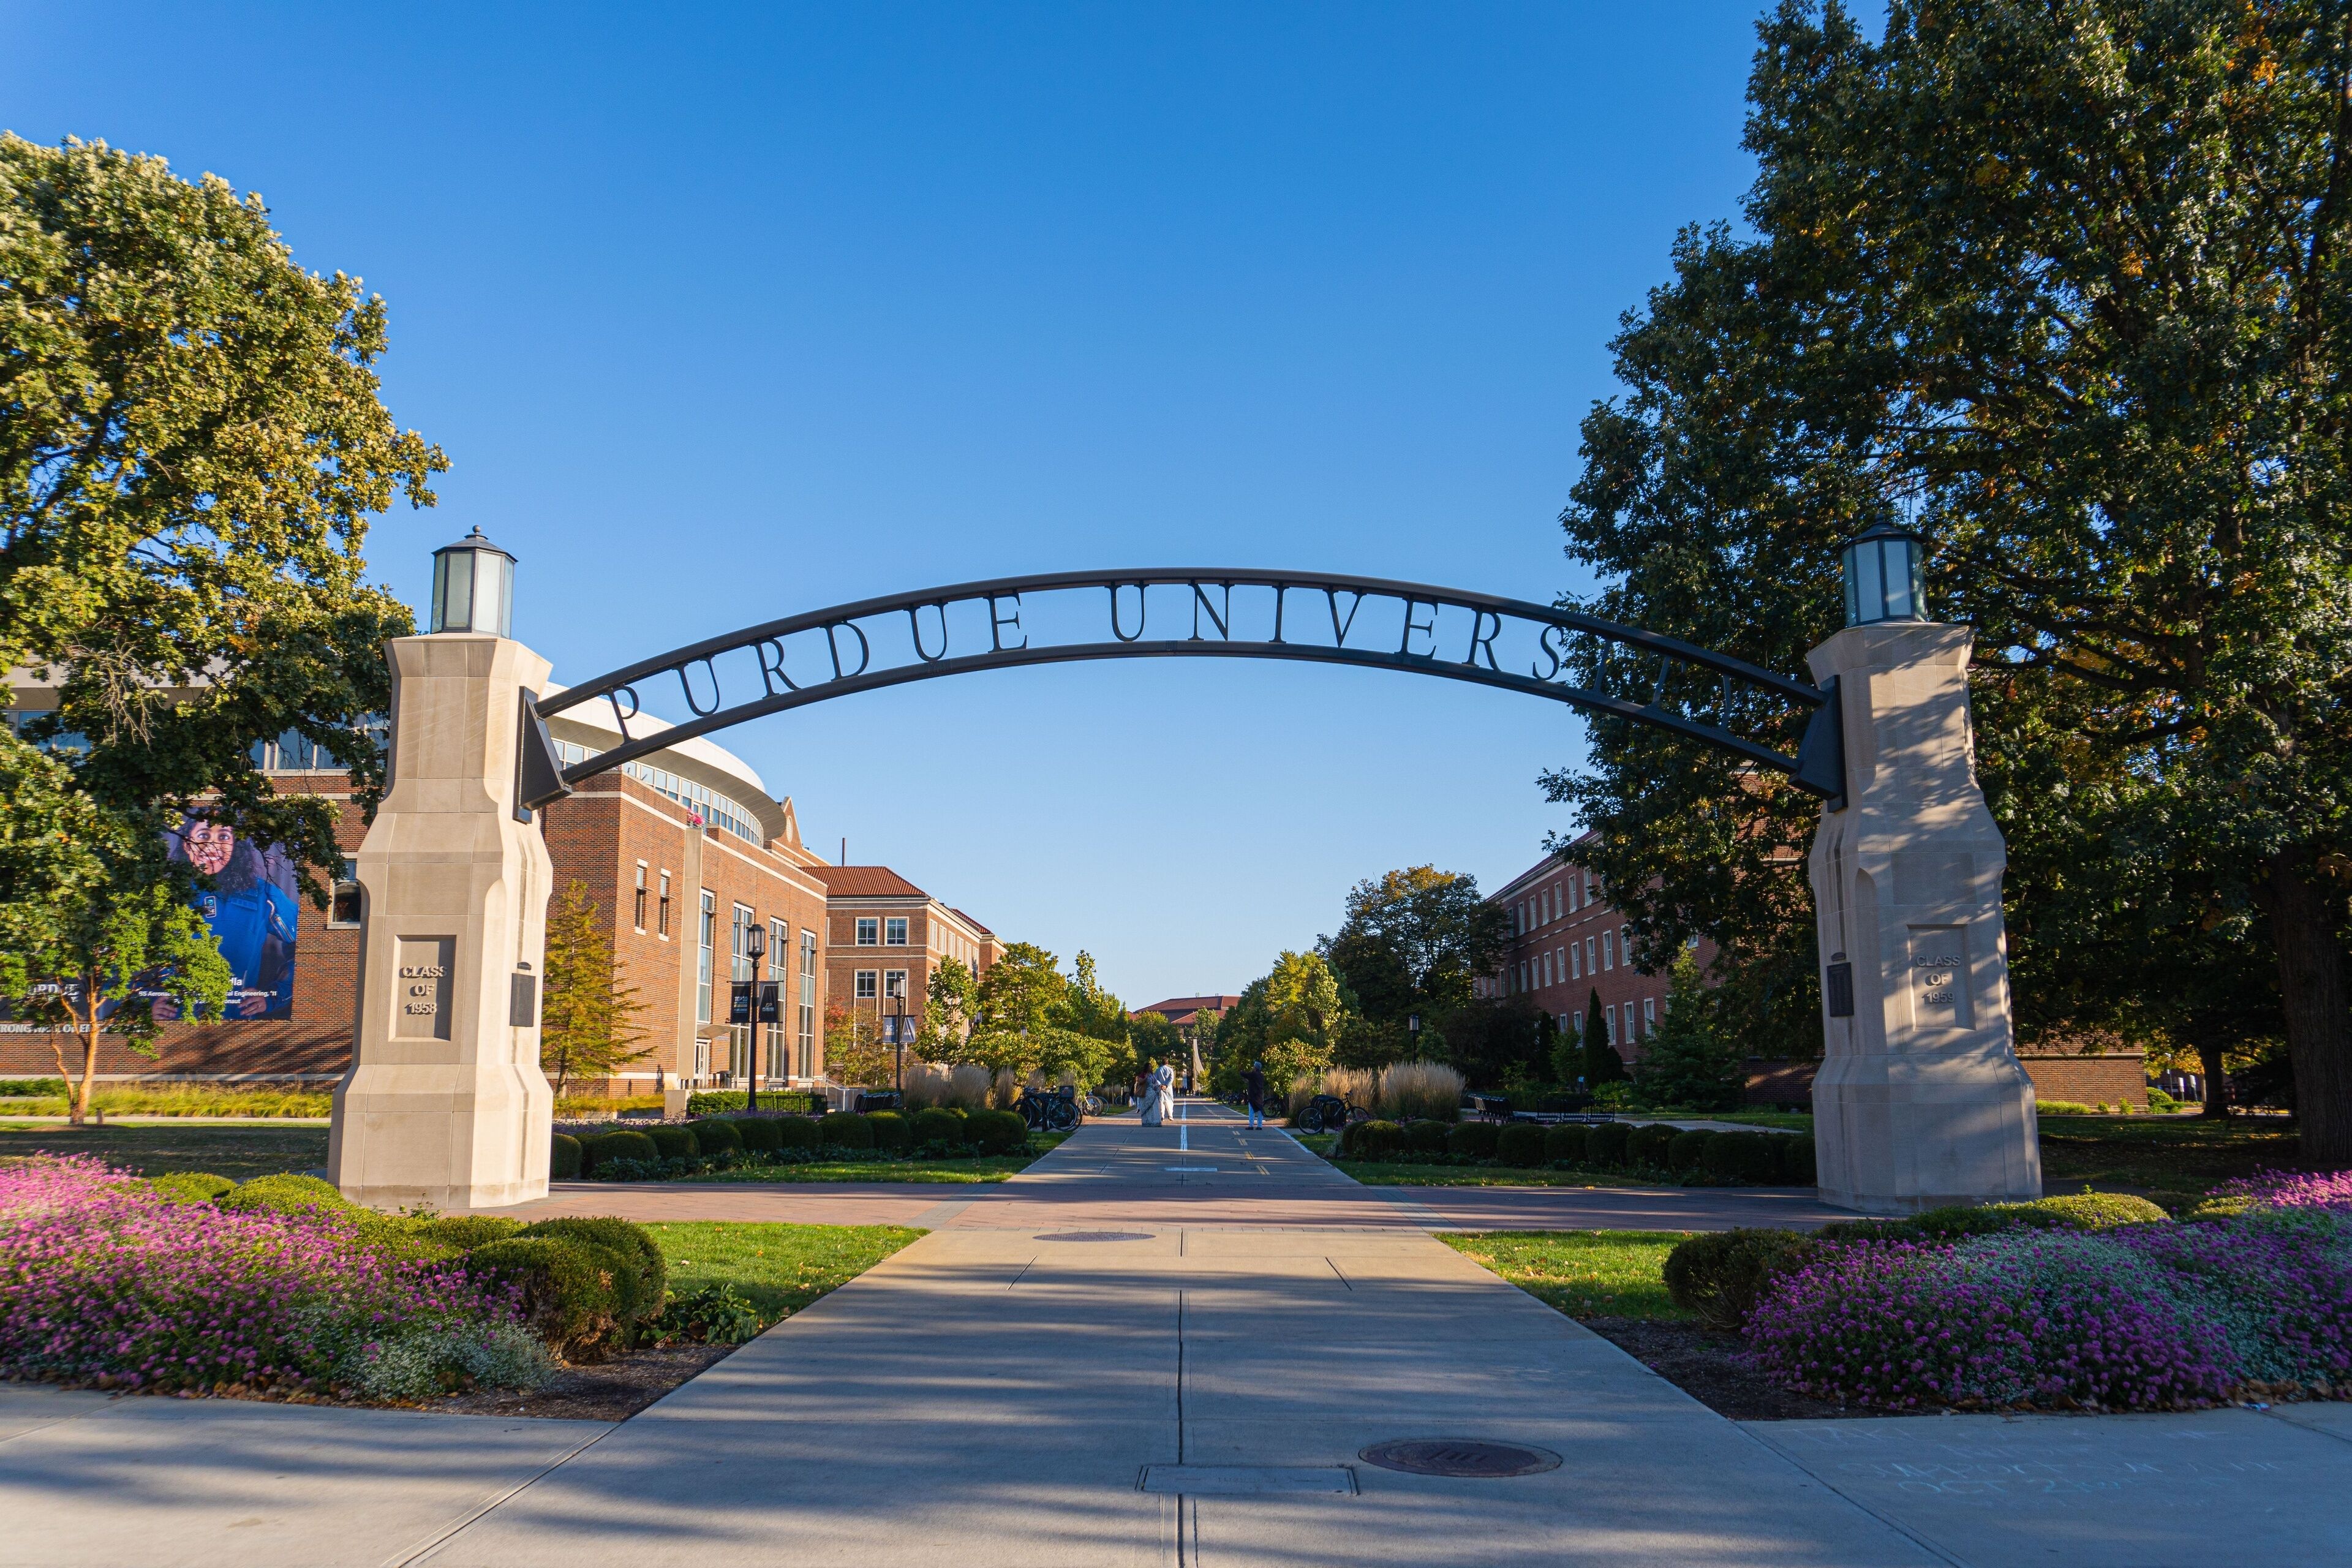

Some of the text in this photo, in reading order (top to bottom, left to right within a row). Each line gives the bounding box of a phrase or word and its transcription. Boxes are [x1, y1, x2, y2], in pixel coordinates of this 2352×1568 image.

[602, 591, 1028, 747] PURDUE
[1917, 956, 1960, 967] CLASS
[401, 966, 447, 978] CLASS
[1931, 974, 1951, 984] OF
[414, 984, 435, 995] OF
[1927, 992, 1955, 1003] 1959
[409, 1003, 437, 1014] 1958
